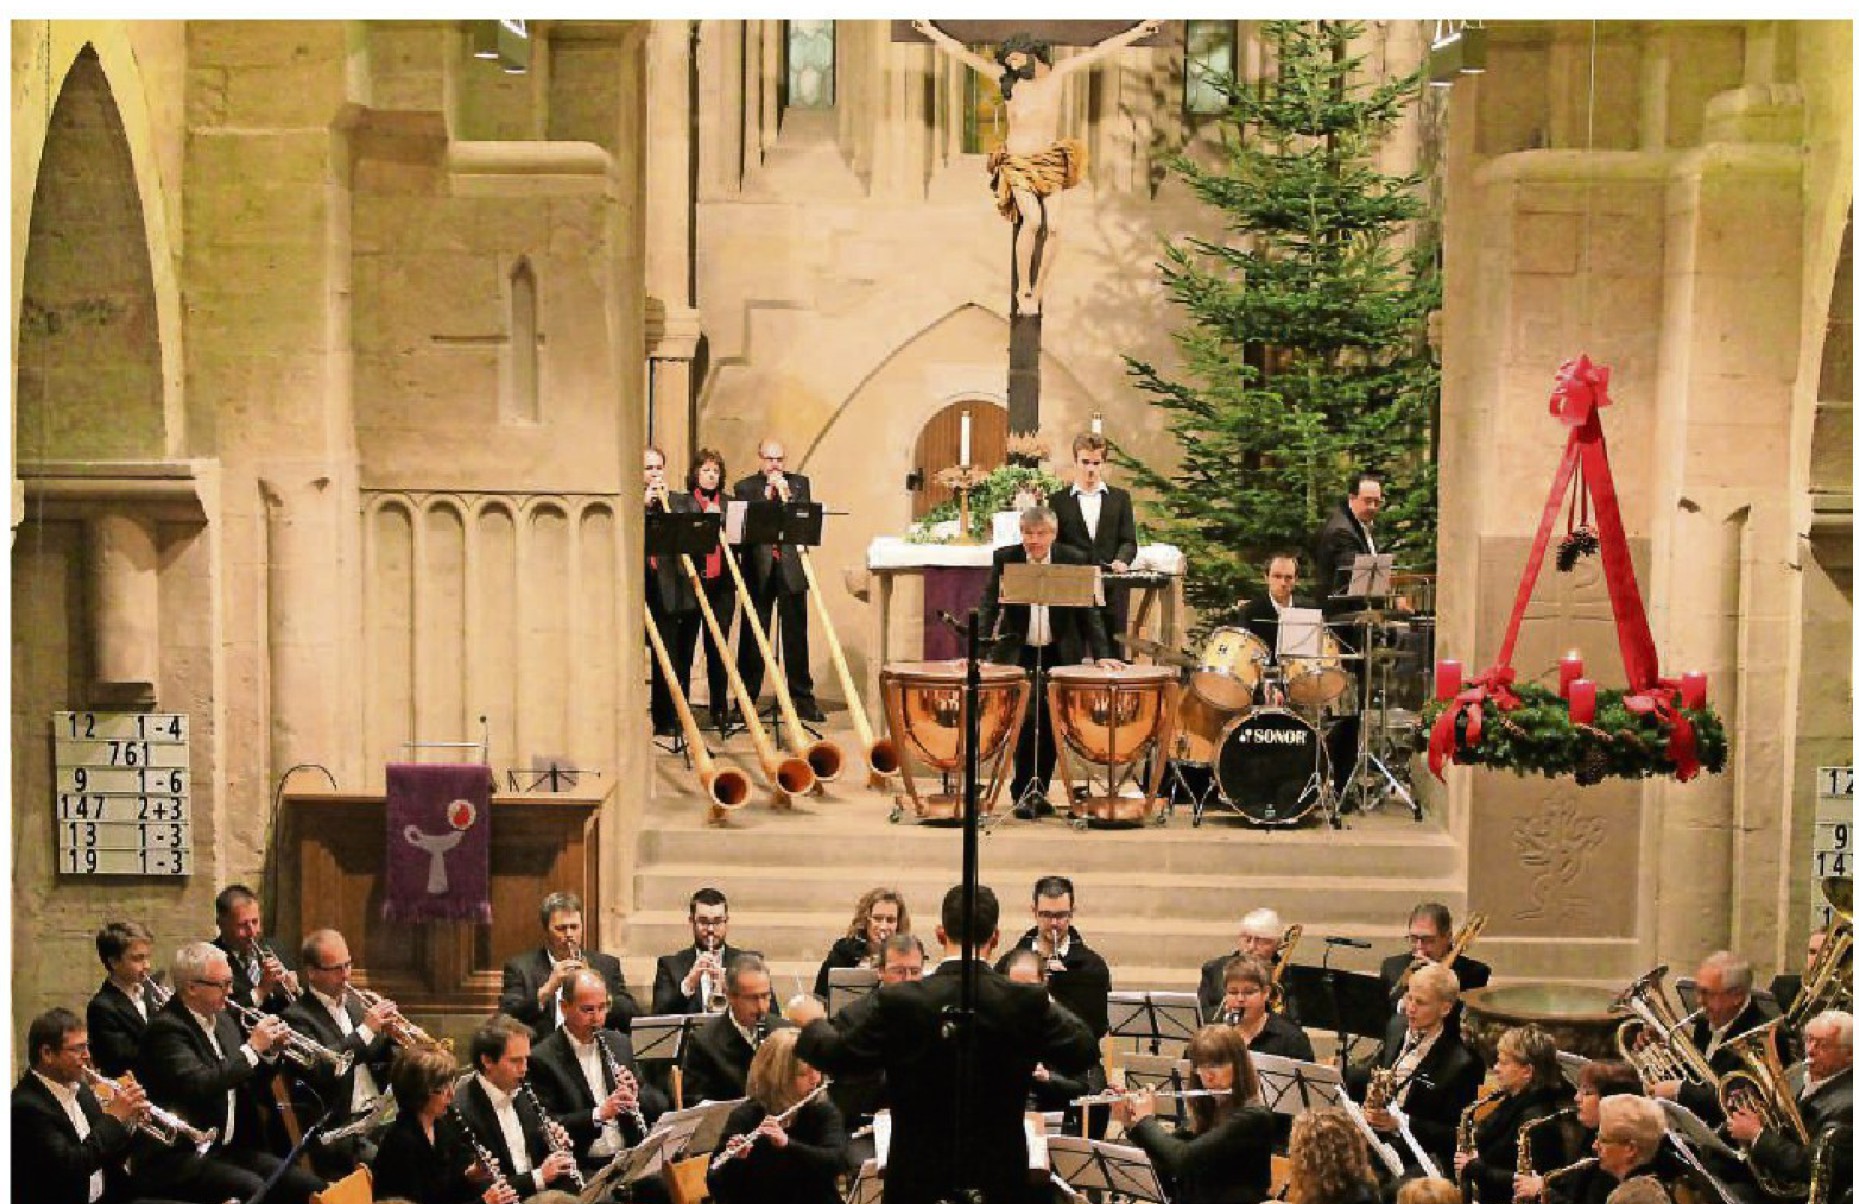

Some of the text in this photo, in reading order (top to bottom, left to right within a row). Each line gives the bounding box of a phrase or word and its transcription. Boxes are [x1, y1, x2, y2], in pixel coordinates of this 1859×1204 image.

[69, 714, 95, 738] 12
[1253, 728, 1308, 745] SONOR
[108, 741, 148, 765] 761
[75, 768, 87, 792] 9
[62, 796, 105, 819] 147
[69, 824, 96, 847] 13
[1834, 824, 1848, 849] 9
[69, 851, 96, 873] 19
